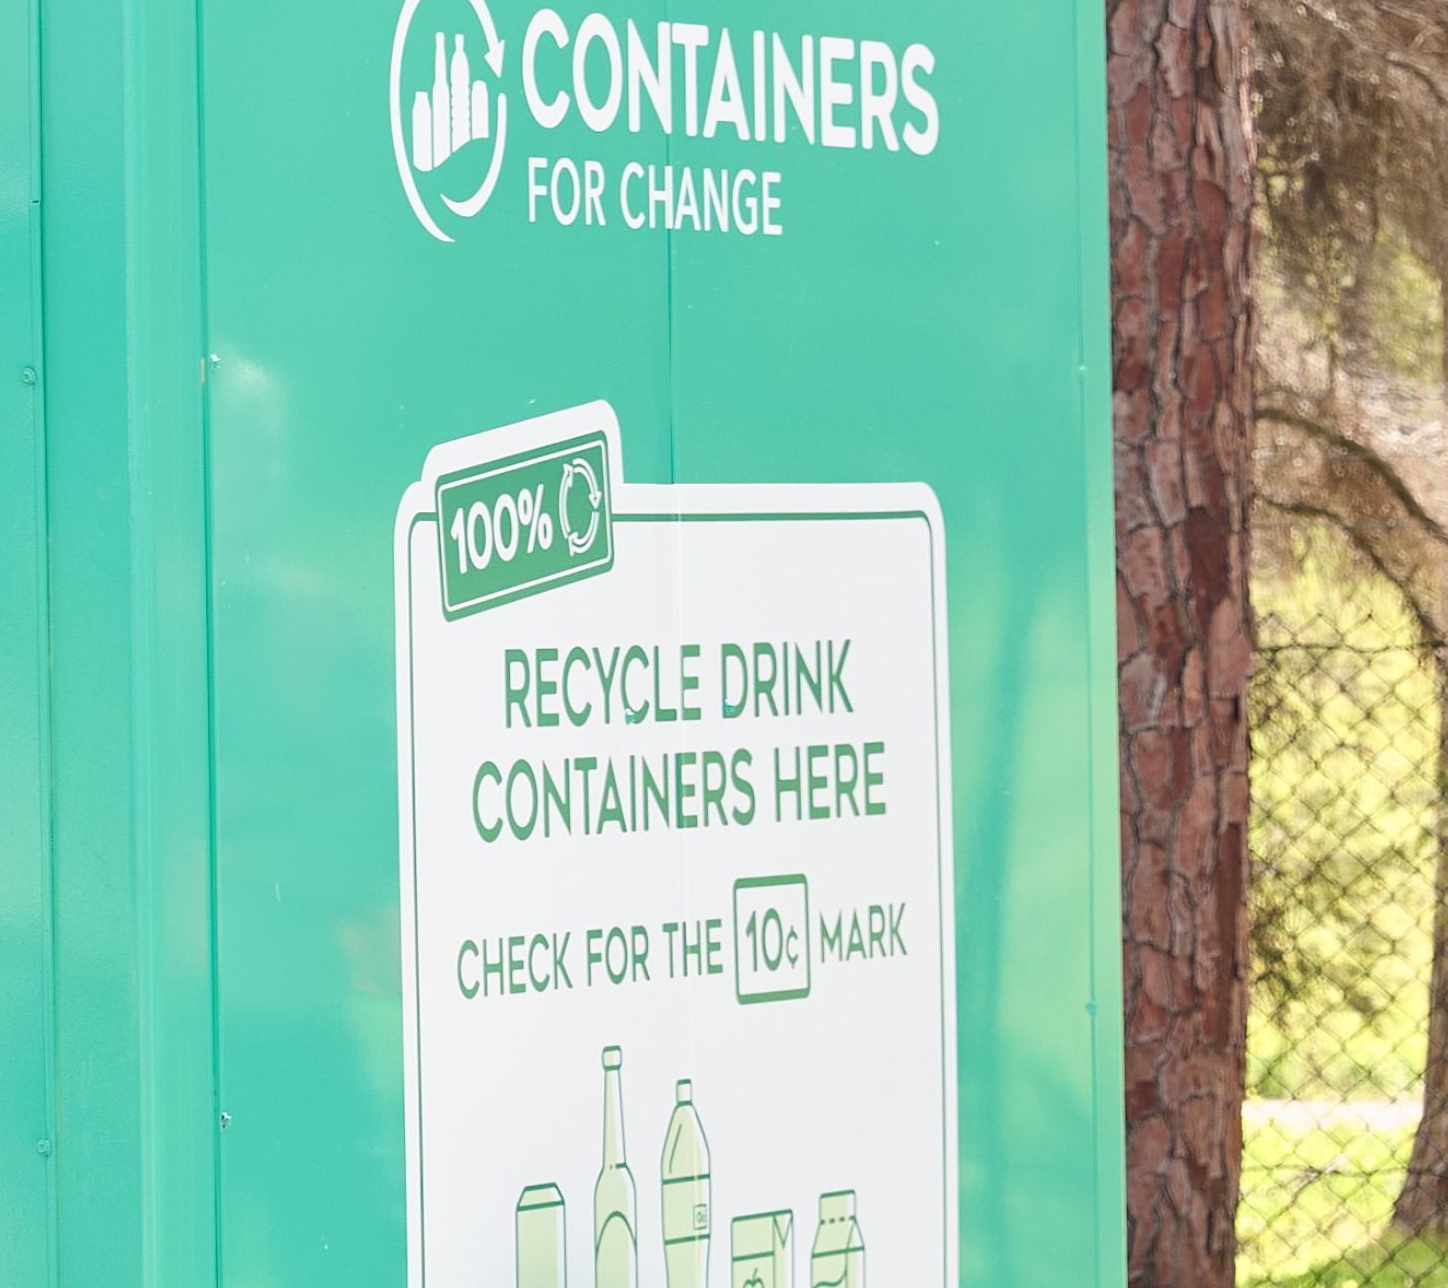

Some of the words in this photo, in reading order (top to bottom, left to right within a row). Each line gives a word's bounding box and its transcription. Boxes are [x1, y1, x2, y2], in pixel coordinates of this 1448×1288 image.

[522, 9, 939, 155] CONTAINERS
[529, 157, 606, 226] FOR
[621, 162, 782, 235] CHANGE
[450, 485, 553, 574] 100%
[505, 644, 701, 728] RECYCLE
[721, 639, 854, 719] DRINK
[473, 748, 755, 843] CONTAINERS
[774, 742, 886, 822] HERE
[457, 932, 573, 1000] CHECK
[586, 924, 650, 987] FOR
[662, 918, 724, 979] THE
[819, 901, 909, 965] MARK
